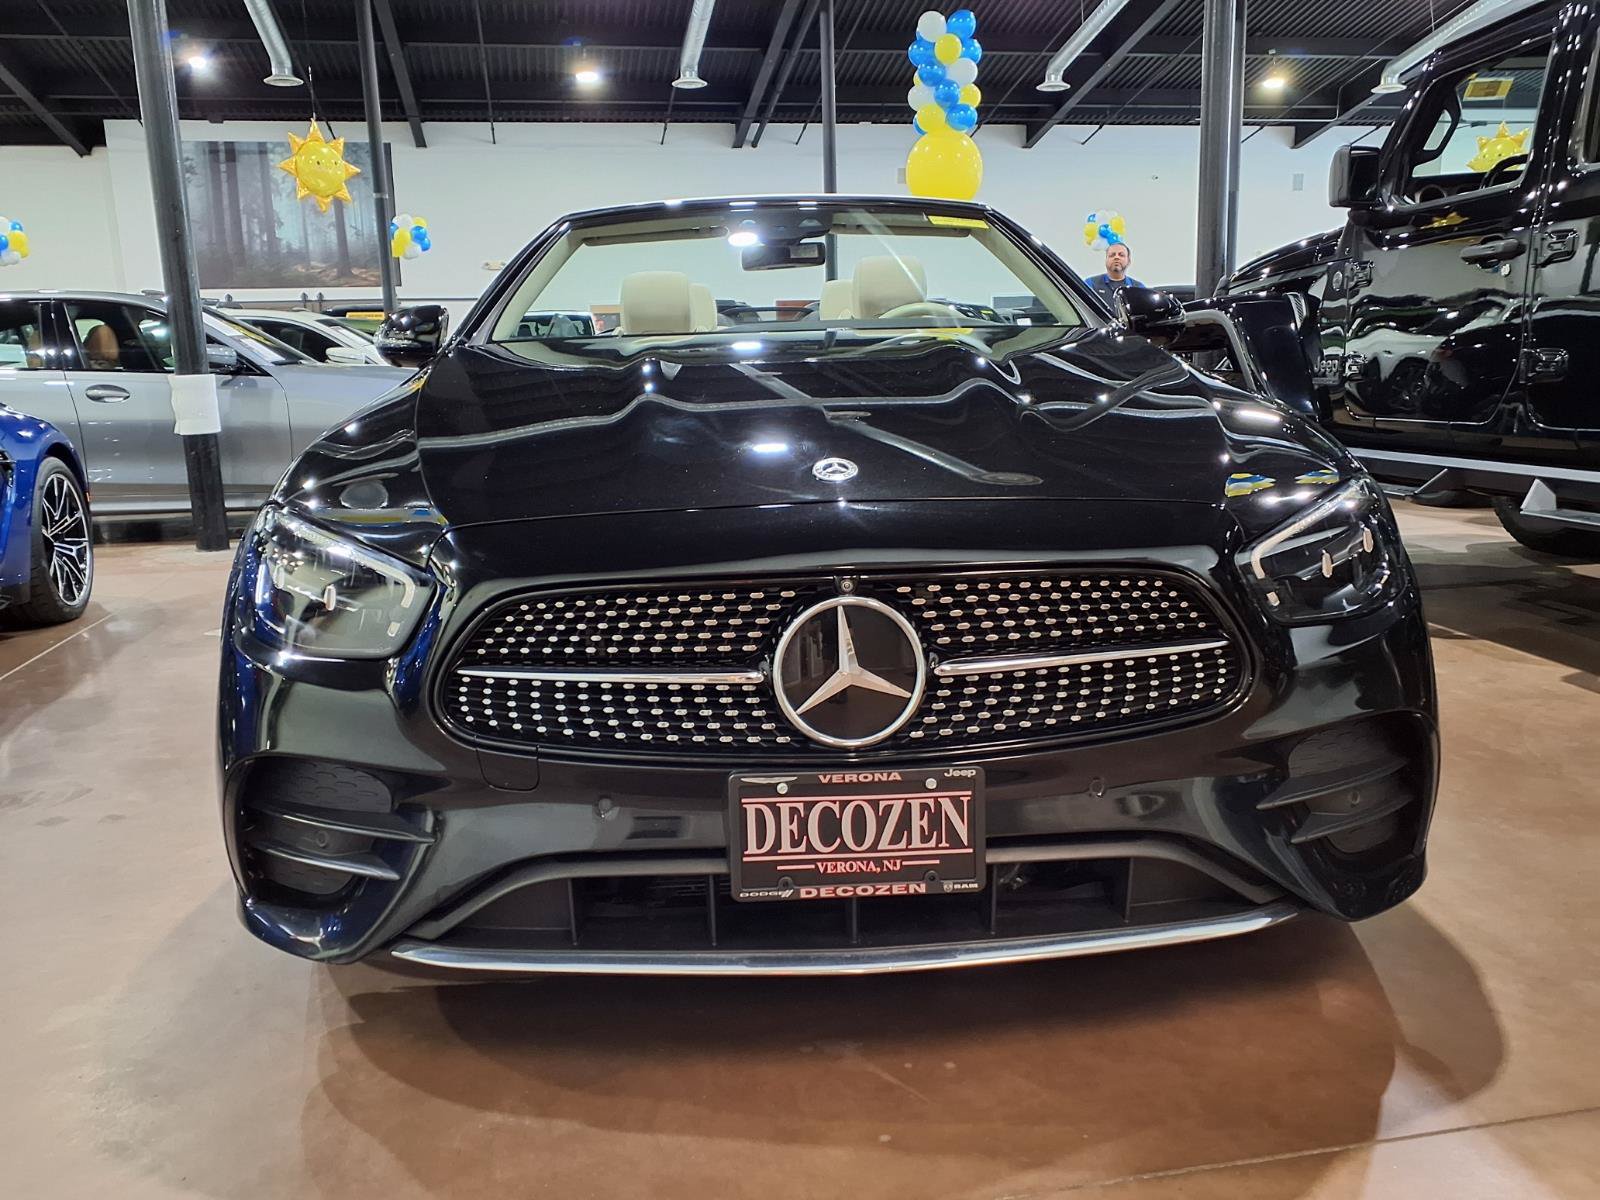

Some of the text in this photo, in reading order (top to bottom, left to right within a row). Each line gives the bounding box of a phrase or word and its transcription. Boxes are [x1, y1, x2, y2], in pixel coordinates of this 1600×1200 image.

[818, 771, 902, 784] VERONA
[943, 768, 976, 778] Jeep
[743, 796, 971, 855] DECOZEN
[816, 859, 903, 873] VERONA, NJ
[800, 883, 926, 898] DECOZEN
